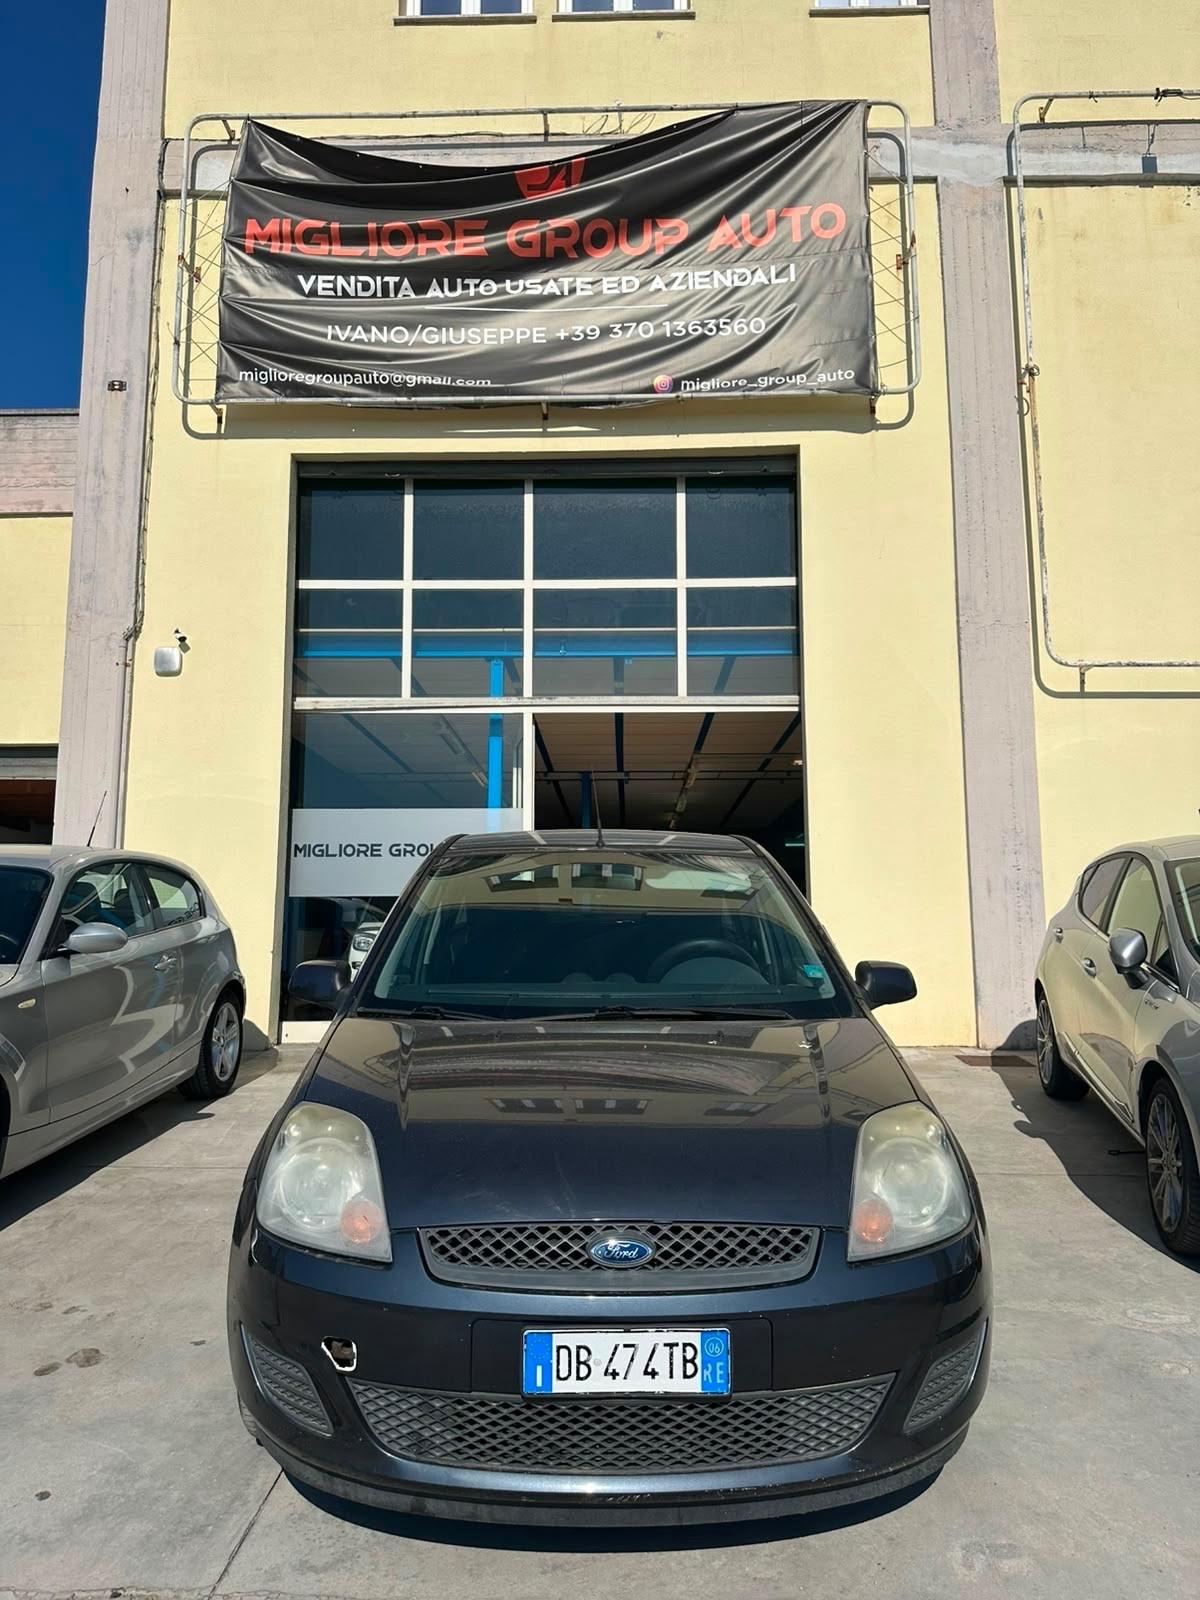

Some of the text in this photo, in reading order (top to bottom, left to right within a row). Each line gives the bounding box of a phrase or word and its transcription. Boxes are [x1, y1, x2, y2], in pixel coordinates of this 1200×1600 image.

[244, 202, 847, 259] MIGLIORE GROUP AUTO
[297, 262, 796, 299] VENDITA AUTO USATE ED AZIENDALI
[326, 316, 767, 346] IVANO/GIUSEPPE +39 370 1363560
[238, 367, 493, 387] miglioregroupauto@gmail.com
[680, 367, 856, 393] migliore_group_auto
[293, 843, 383, 858] MIGLIORE
[603, 1241, 639, 1260] Ford
[555, 1344, 593, 1382] DB
